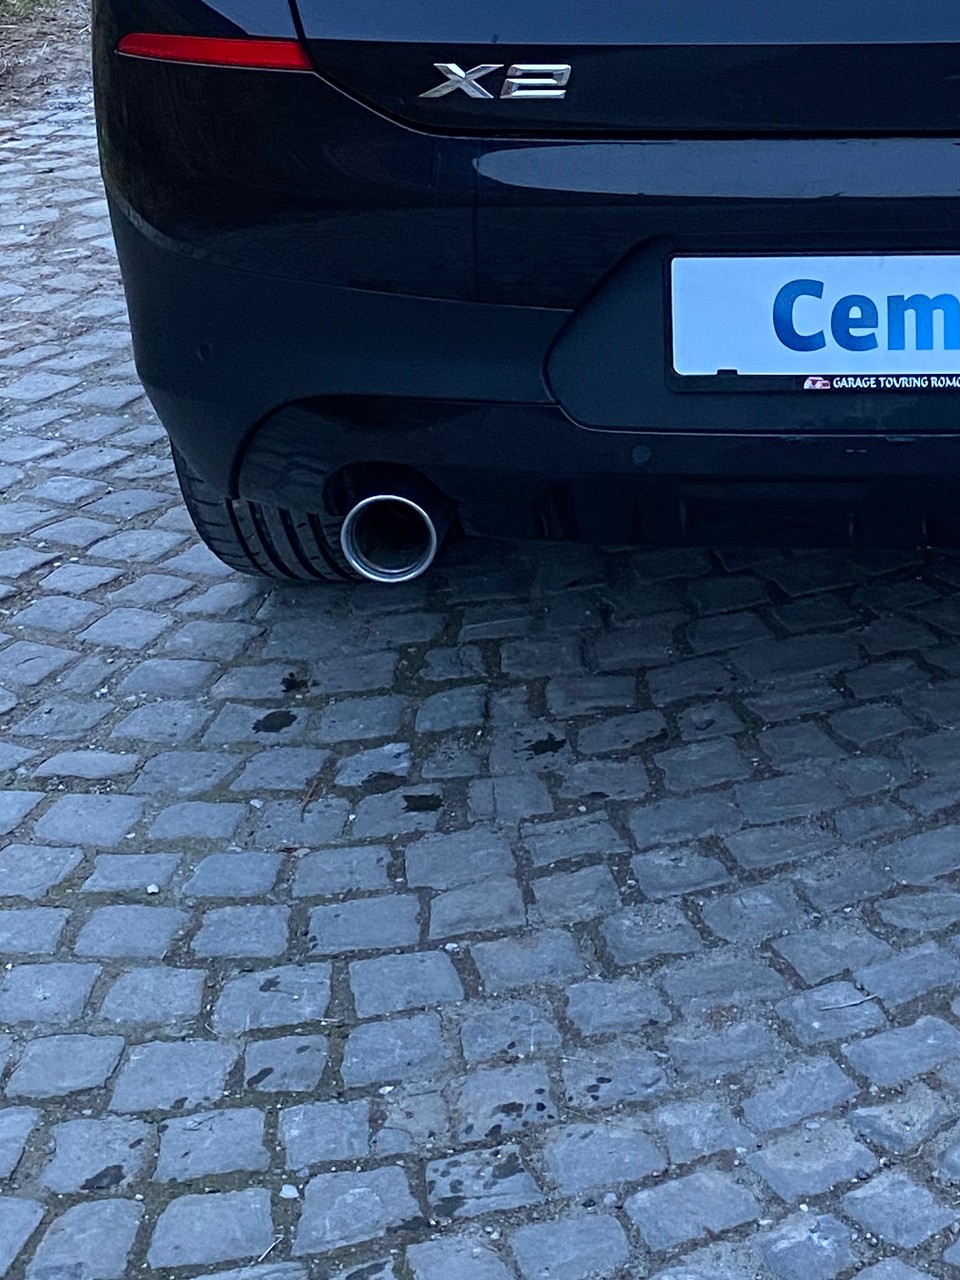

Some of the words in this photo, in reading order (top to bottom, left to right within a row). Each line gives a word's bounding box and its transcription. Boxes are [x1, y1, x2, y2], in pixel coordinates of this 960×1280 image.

[418, 63, 571, 99] X2
[833, 377, 877, 388] GARAGE
[878, 377, 928, 388] TOURING
